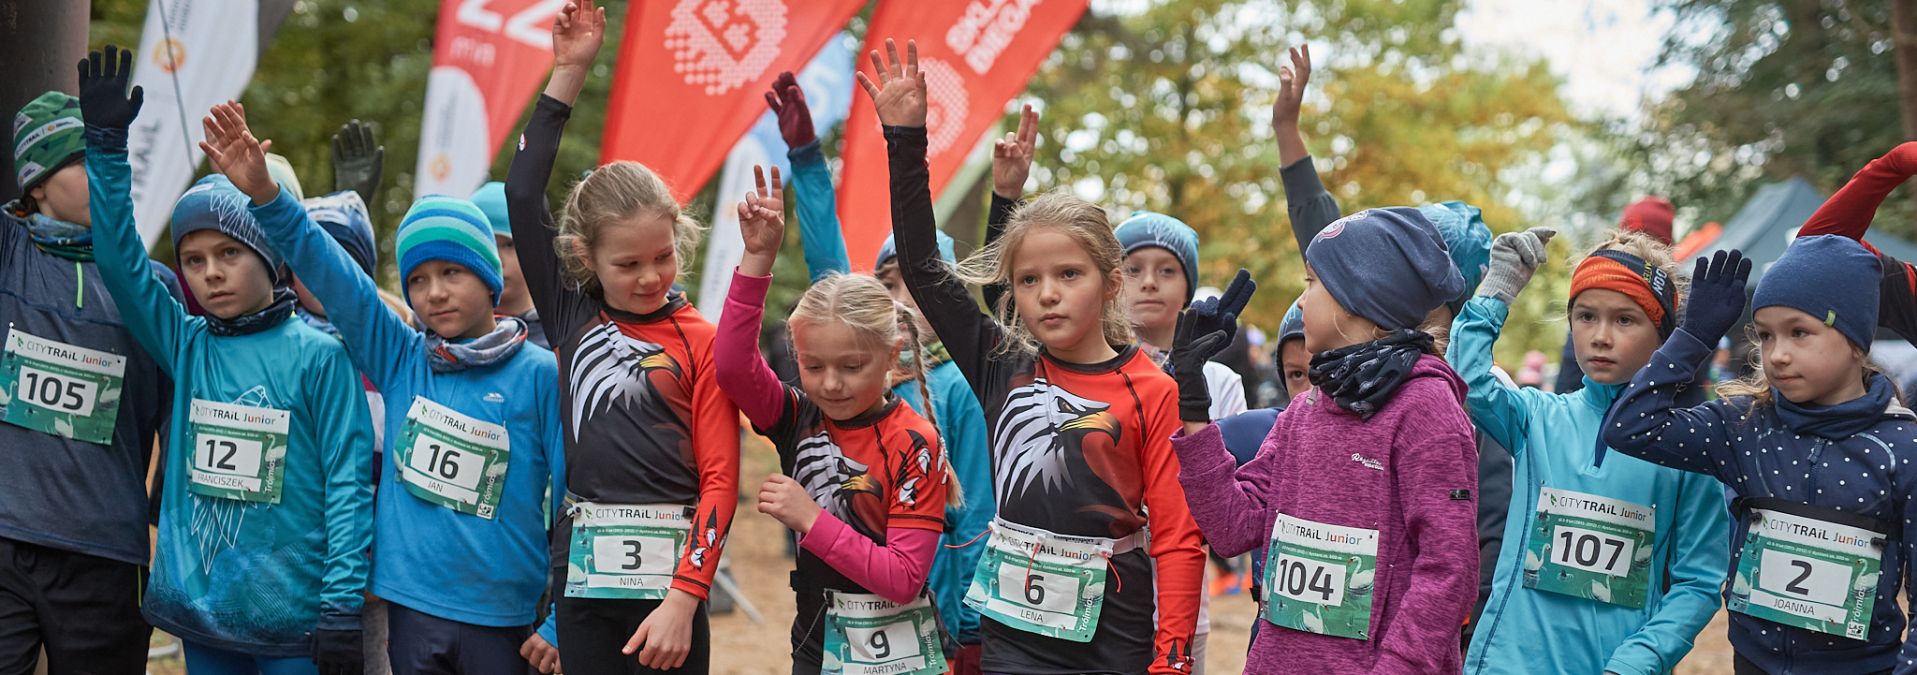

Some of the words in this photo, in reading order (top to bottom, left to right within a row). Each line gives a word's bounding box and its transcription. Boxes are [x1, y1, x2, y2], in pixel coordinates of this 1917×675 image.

[82, 355, 112, 367] Junior
[26, 372, 86, 411] 105
[243, 413, 276, 425] Junior
[470, 426, 501, 441] Junior
[206, 439, 238, 471] 12
[428, 443, 461, 480] 16
[198, 473, 244, 488] FRANCISZEK
[427, 480, 444, 493] JAN
[1619, 507, 1647, 521] Junior
[1325, 531, 1362, 545] Junior
[1832, 531, 1869, 547] Junior
[621, 540, 642, 570] 3
[1060, 547, 1095, 561] Junior
[1560, 531, 1625, 571] 107
[619, 577, 644, 587] NINA
[1279, 558, 1334, 601] 104
[1785, 559, 1813, 596] 2
[1024, 574, 1045, 605] 6
[1773, 598, 1815, 616] JOANNA
[1020, 609, 1044, 622] LENA
[870, 630, 891, 659] 9
[863, 662, 907, 675] MARTYNA
